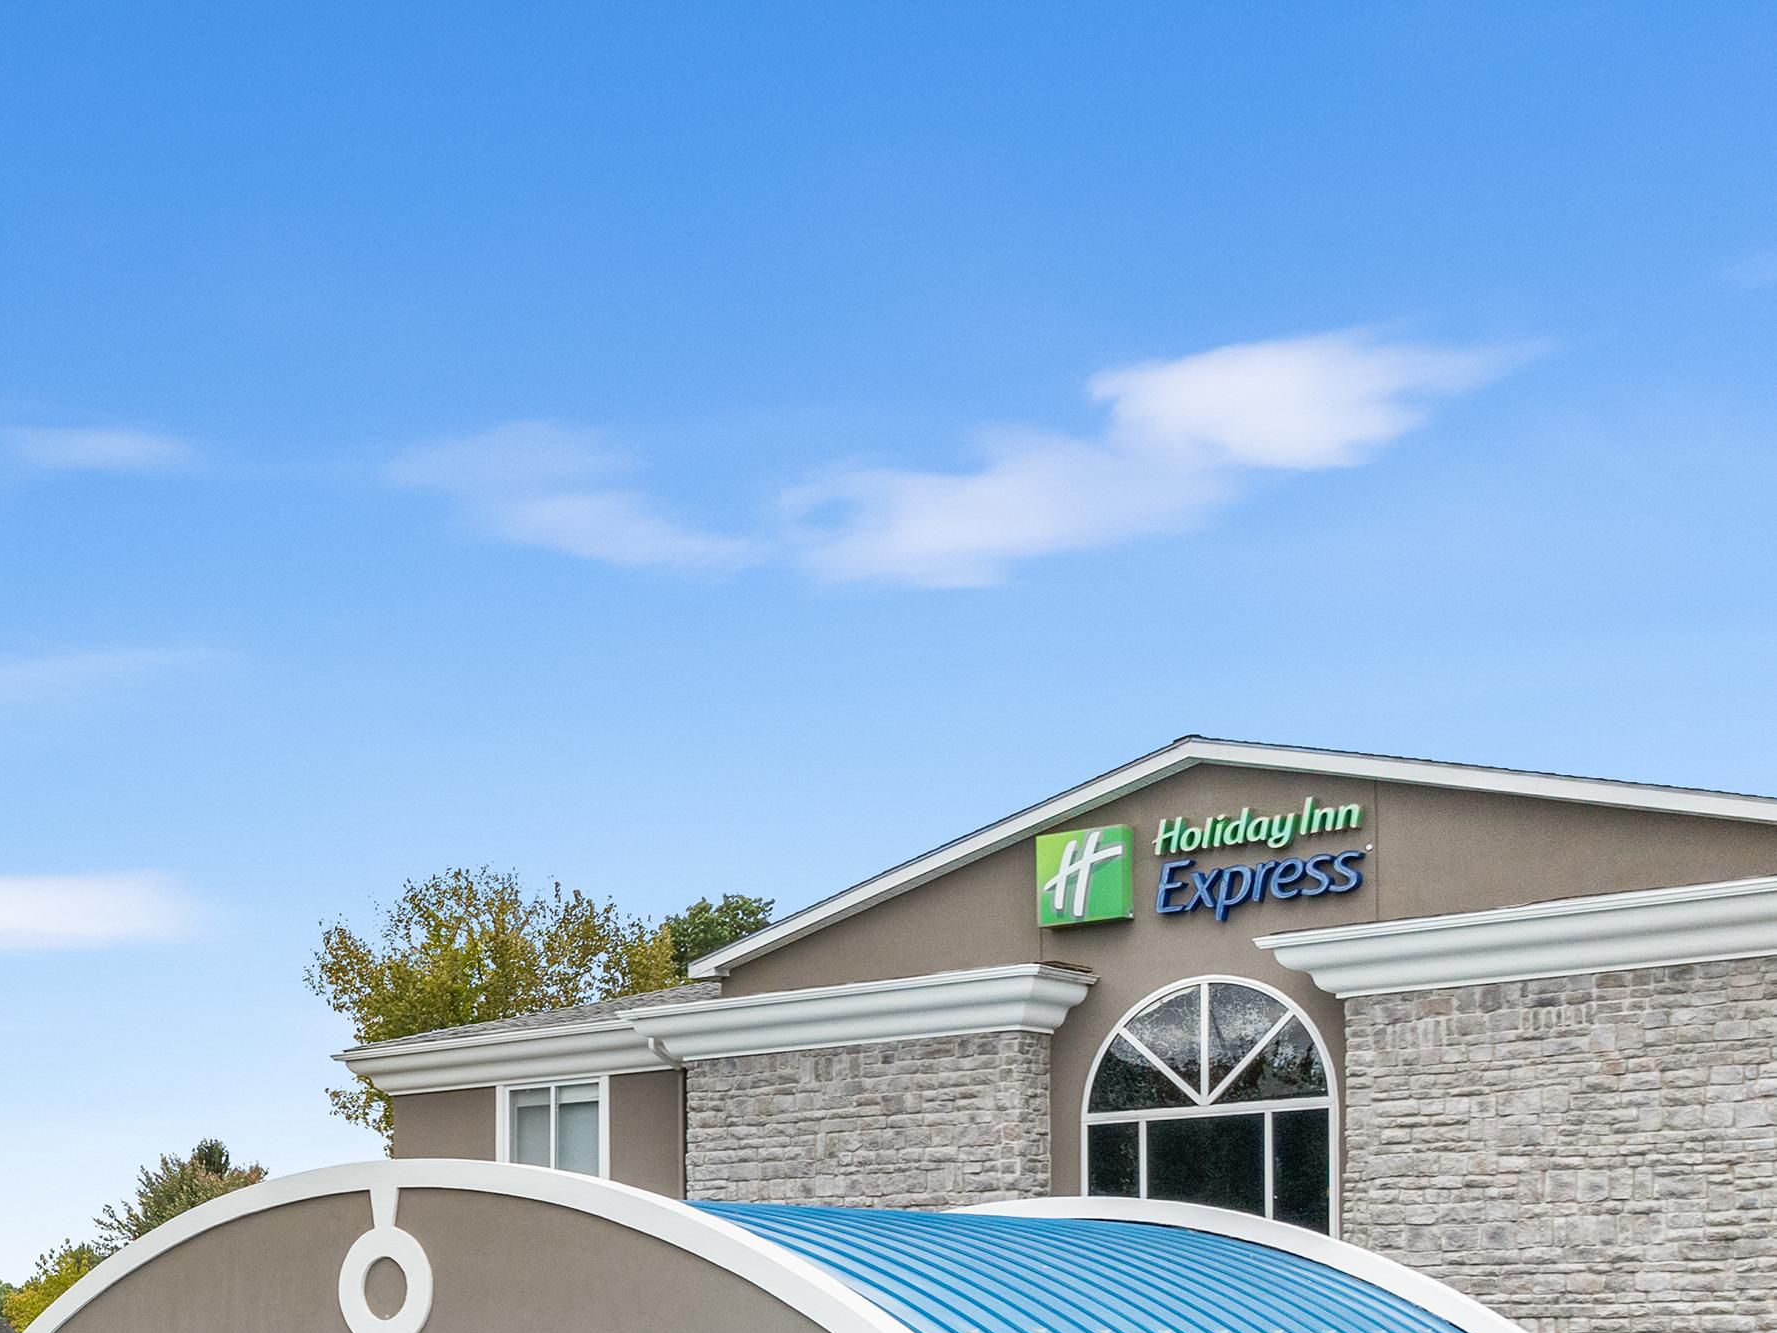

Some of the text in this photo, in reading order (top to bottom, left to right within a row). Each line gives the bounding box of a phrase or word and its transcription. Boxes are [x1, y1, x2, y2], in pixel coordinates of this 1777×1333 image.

[1152, 797, 1363, 856] Holiday Inn
[1156, 850, 1367, 921] Express
